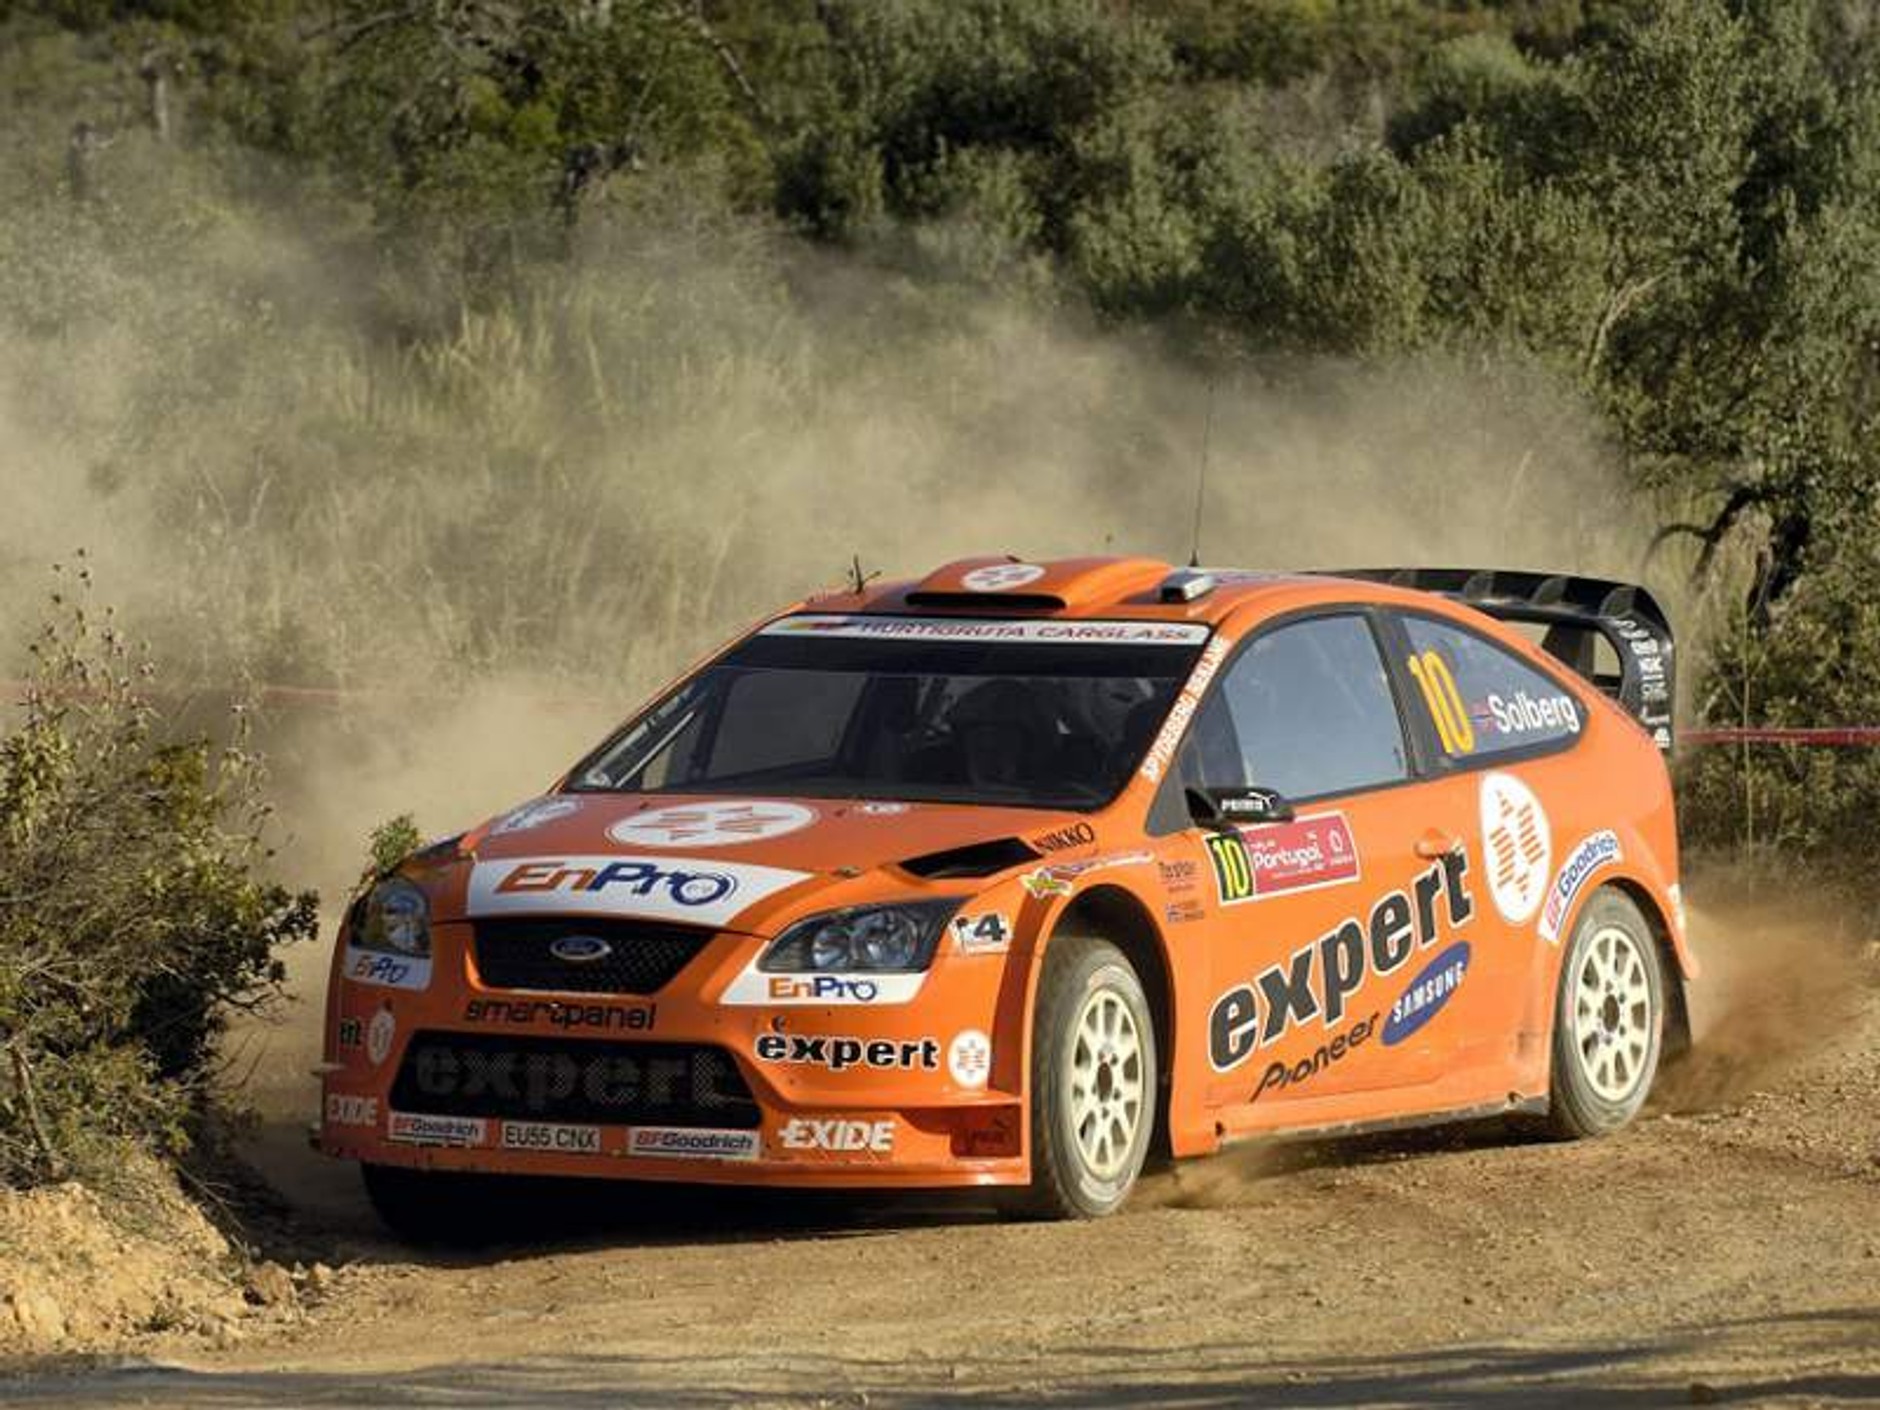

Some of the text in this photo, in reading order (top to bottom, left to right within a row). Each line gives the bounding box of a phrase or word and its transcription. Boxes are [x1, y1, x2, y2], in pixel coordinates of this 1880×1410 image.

[1407, 649, 1474, 754] 10
[1487, 691, 1581, 734] Solberg
[1212, 839, 1250, 898] 10
[1253, 843, 1323, 870] Portugal
[495, 861, 739, 906] EnPro
[1208, 840, 1474, 1072] expert
[769, 977, 877, 1001] EnPro
[1393, 961, 1464, 1023] SAMSUNG
[466, 1000, 657, 1030] smartpanel
[756, 1033, 939, 1072] expert
[1250, 1012, 1380, 1103] Pioneer
[505, 1126, 597, 1148] EU55 CNX
[636, 1130, 754, 1152] BFGoodrich
[779, 1119, 895, 1151] EXIDE
